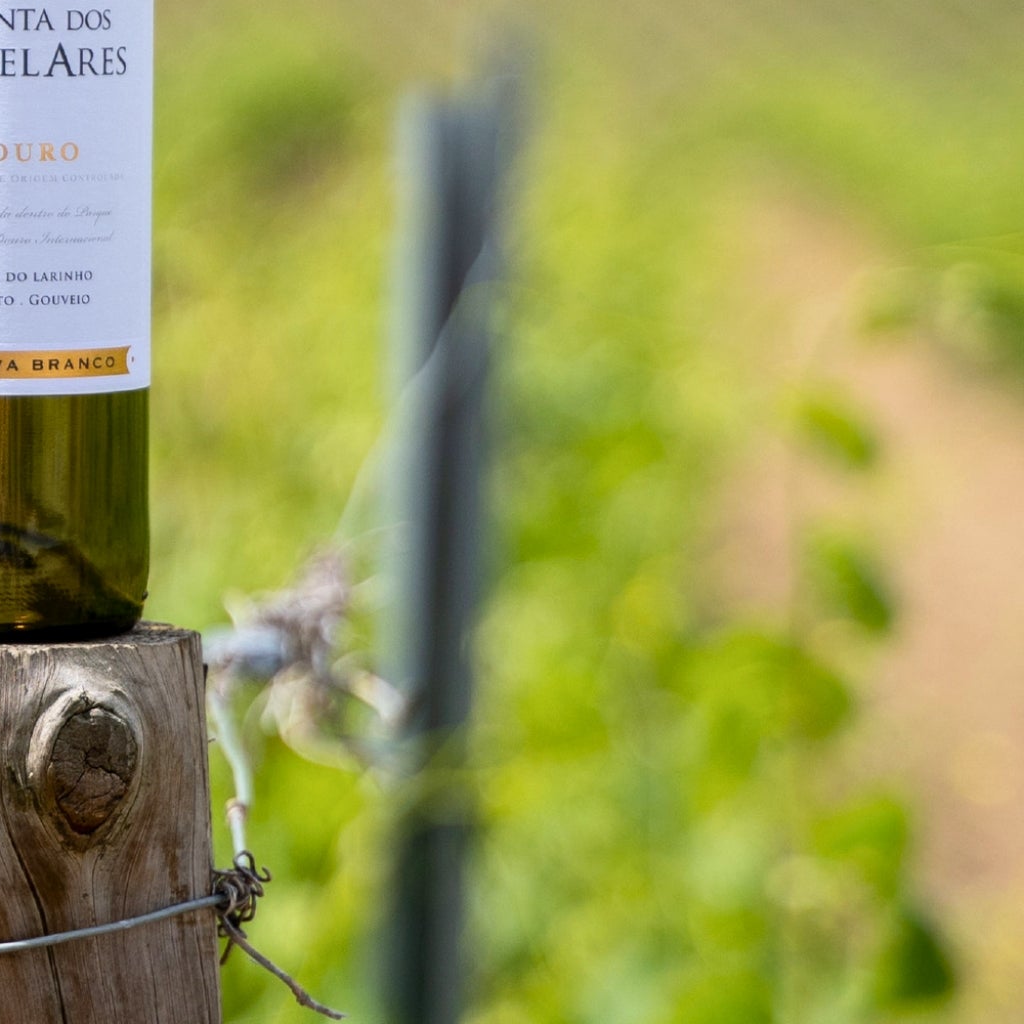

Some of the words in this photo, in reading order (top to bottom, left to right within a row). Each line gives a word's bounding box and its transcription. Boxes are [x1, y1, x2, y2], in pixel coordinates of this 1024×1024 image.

[66, 8, 112, 32] DOS
[6, 271, 27, 282] DO
[33, 270, 93, 282] LARINHO
[29, 293, 90, 306] GOUVEIO
[32, 355, 116, 371] BRANCO
